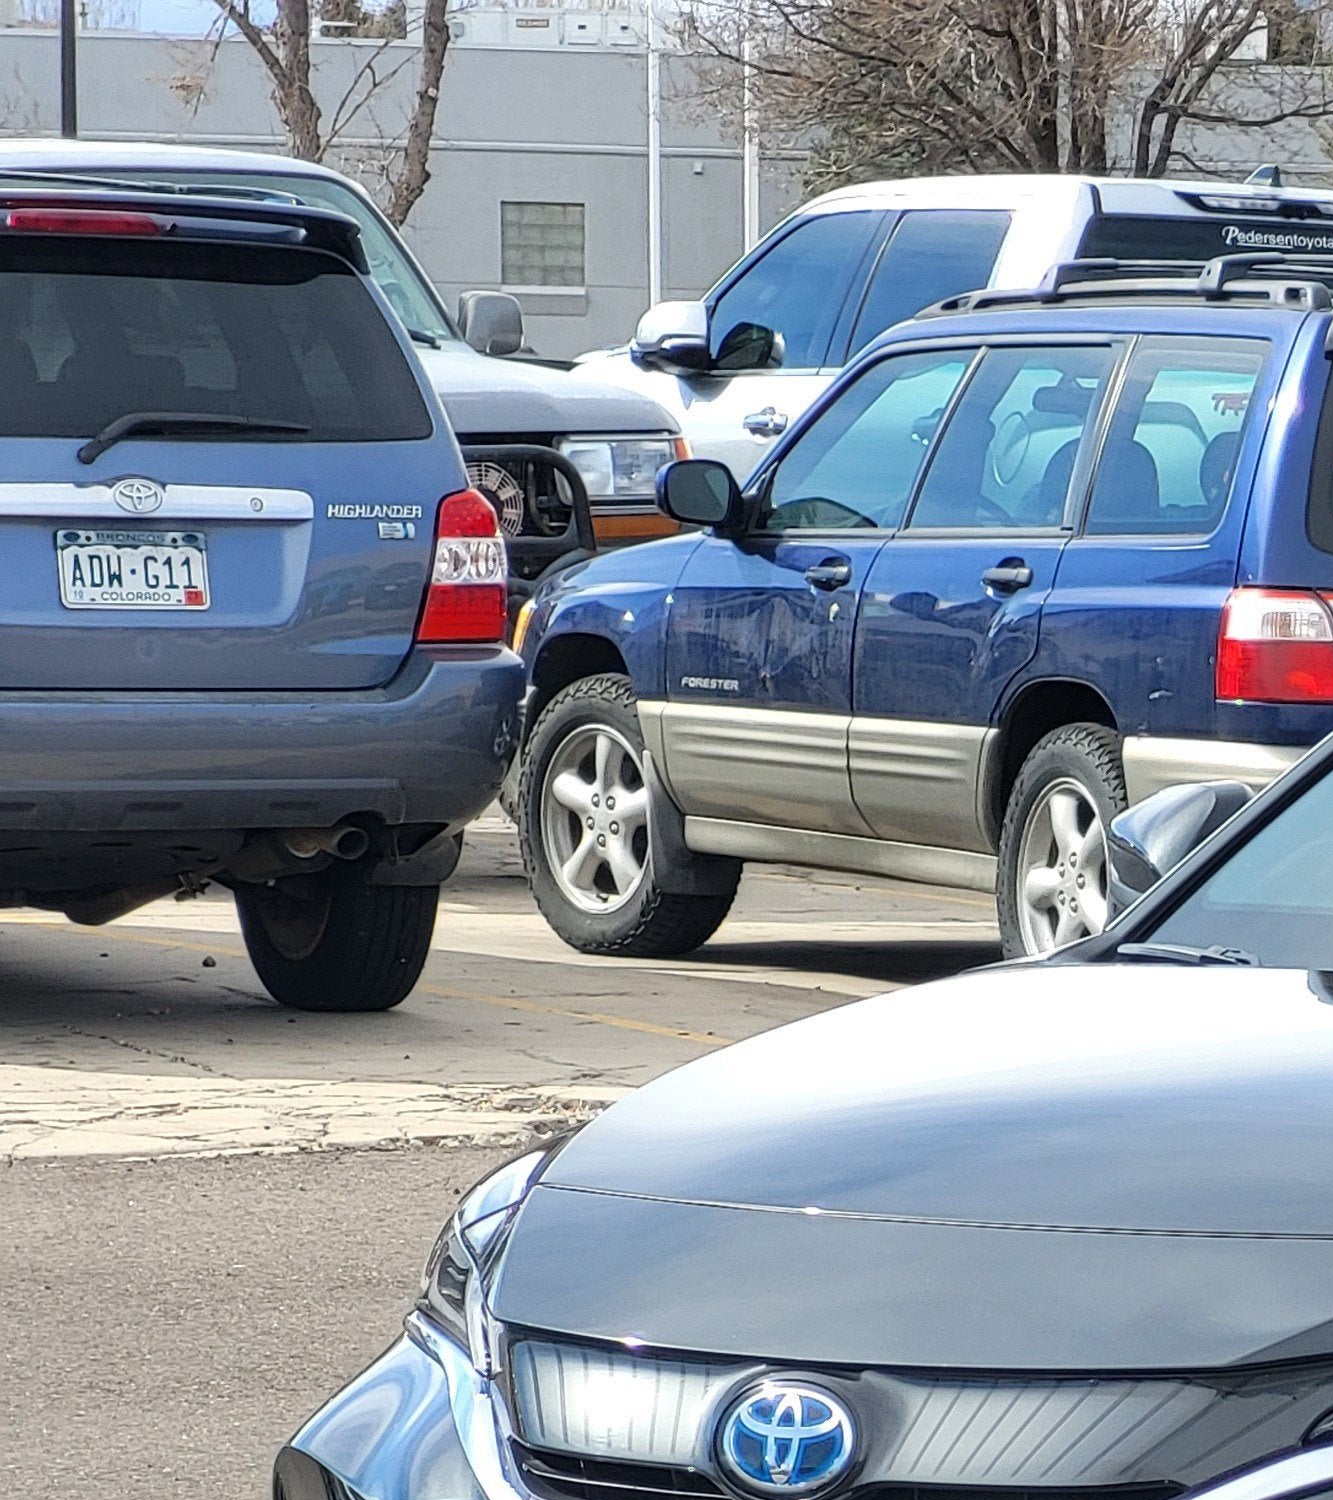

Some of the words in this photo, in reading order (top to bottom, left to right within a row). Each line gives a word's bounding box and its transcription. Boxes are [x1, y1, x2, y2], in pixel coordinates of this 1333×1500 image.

[327, 504, 422, 518] HIGHLANDER
[100, 591, 171, 602] COLORADO
[681, 676, 739, 691] FORESTER
